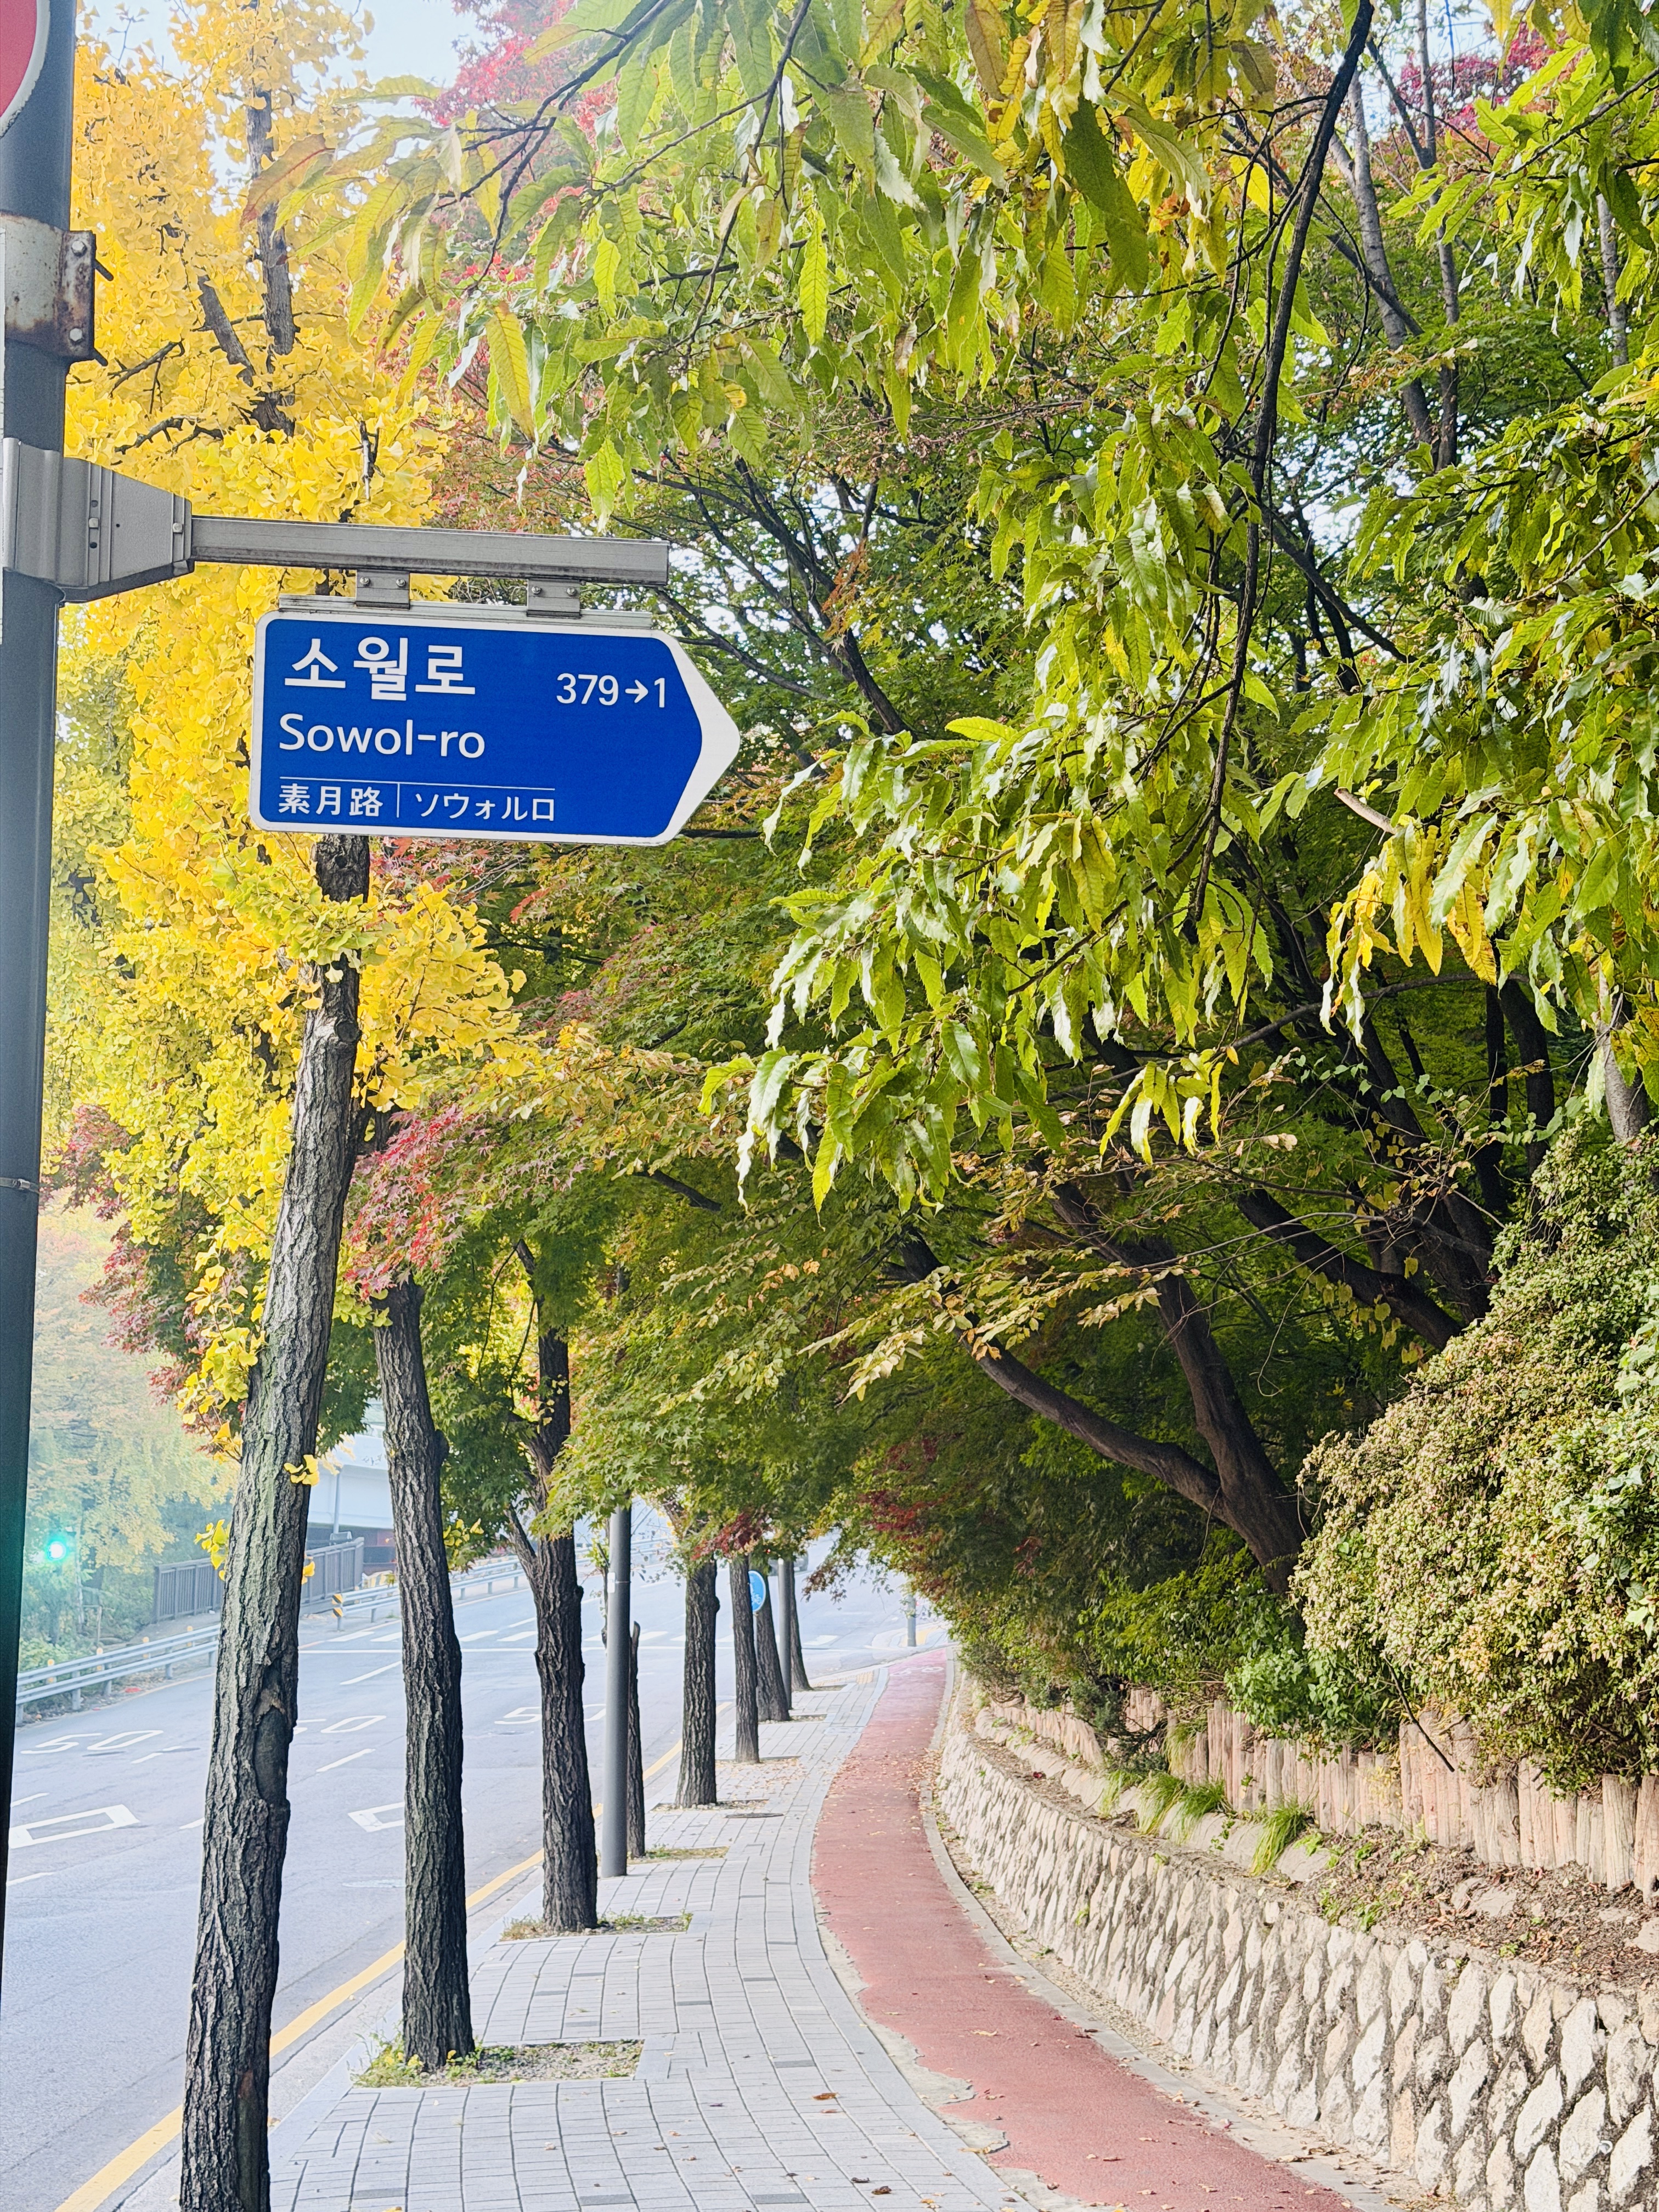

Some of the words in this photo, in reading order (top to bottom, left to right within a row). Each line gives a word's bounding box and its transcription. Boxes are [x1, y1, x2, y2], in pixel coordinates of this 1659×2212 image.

[284, 637, 476, 701] 소월로
[556, 673, 619, 706] 379
[654, 678, 665, 708] 1
[279, 714, 485, 758] Sowol-ro
[278, 783, 383, 816] 素月路
[415, 793, 555, 821] ソウォルロ
[20, 1730, 163, 1754] 50
